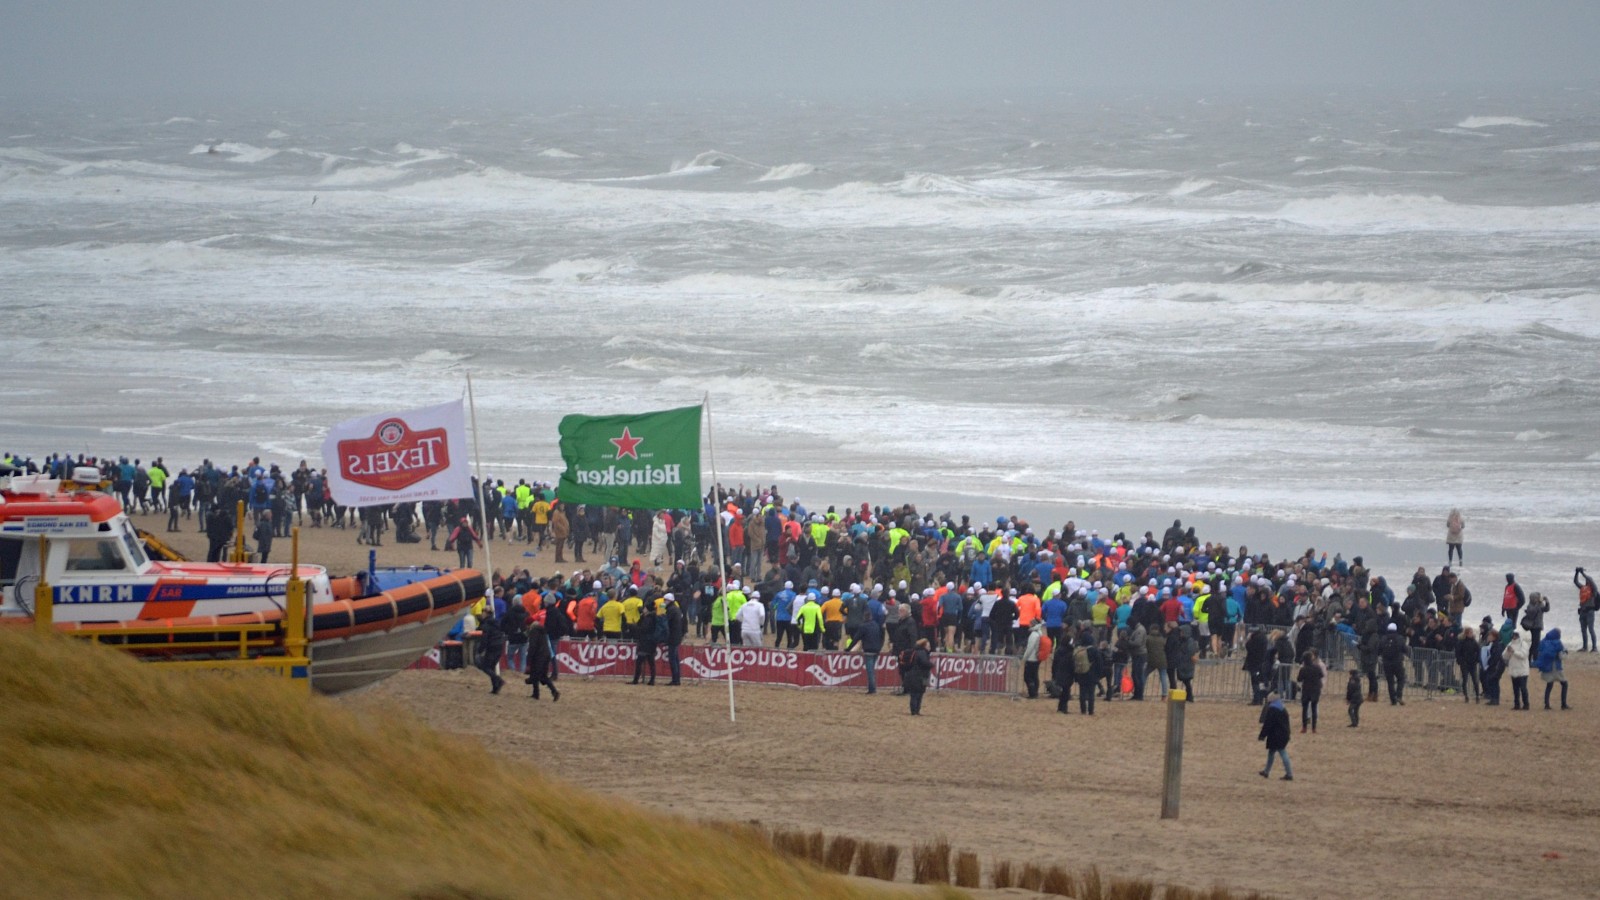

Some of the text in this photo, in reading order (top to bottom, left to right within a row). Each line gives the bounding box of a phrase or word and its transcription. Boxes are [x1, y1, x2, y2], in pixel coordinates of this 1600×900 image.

[60, 584, 134, 602] KNRM
[161, 587, 183, 598] SAR
[226, 585, 287, 594] ADRIAAN HEN
